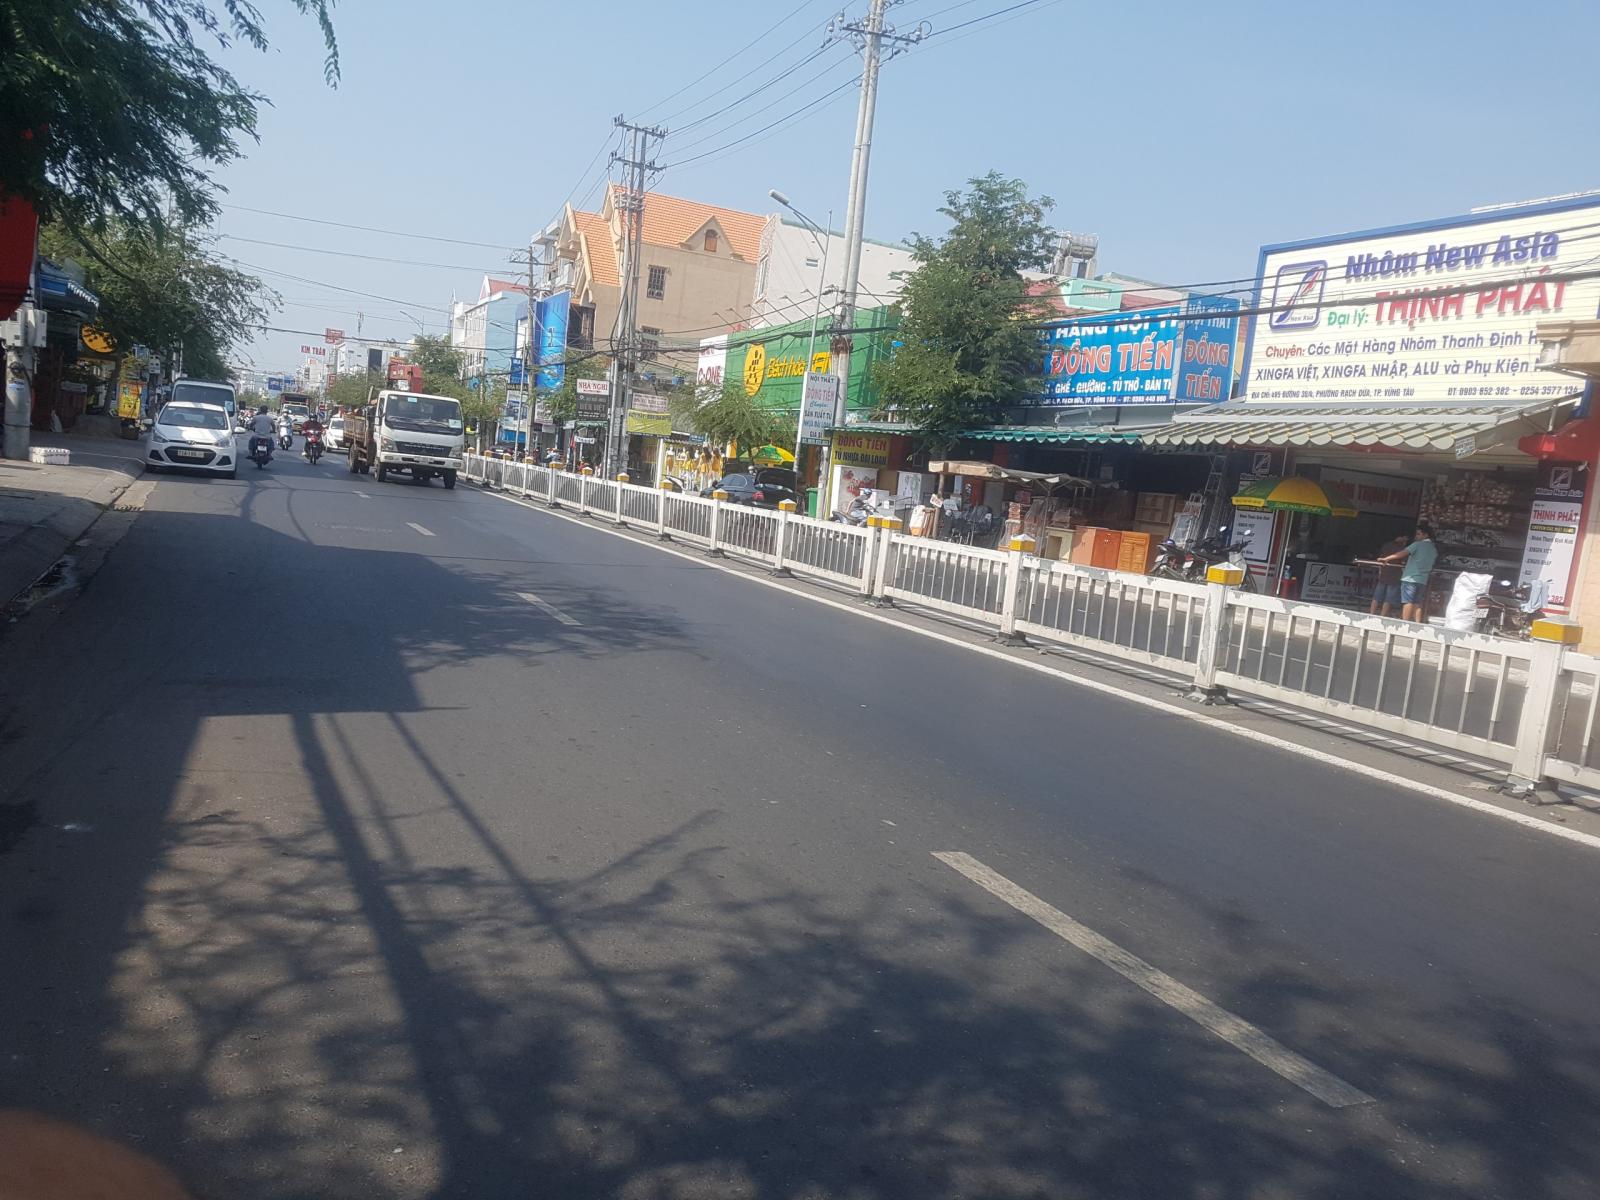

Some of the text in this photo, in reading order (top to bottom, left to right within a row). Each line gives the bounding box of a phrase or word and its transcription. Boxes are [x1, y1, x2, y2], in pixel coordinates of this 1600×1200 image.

[1345, 231, 1559, 279] Nhôm New Asia
[1375, 265, 1566, 327] THỊNH PHÁT
[1327, 307, 1369, 328] Đại lý:
[1050, 331, 1174, 375] ĐỒNG TIẾN
[1184, 331, 1229, 367] ĐỒNG
[1265, 345, 1305, 360] Chuyên:
[1308, 342, 1330, 356] Các
[1334, 340, 1358, 357] Mặt
[1363, 338, 1396, 355] Hàng
[1400, 336, 1437, 351] Nhôm
[1442, 334, 1484, 349] Thanh
[1490, 331, 1522, 348] Định
[1186, 368, 1221, 400] TIẾN
[1255, 367, 1294, 381] XINGFA
[1296, 364, 1319, 381] VIỆT,
[1322, 364, 1366, 379] XINGFA
[1371, 360, 1408, 379] NHẬP,
[1412, 361, 1439, 376] ALU
[1444, 360, 1460, 375] và
[1464, 360, 1491, 377] Phụ
[1495, 358, 1529, 376] Kiện
